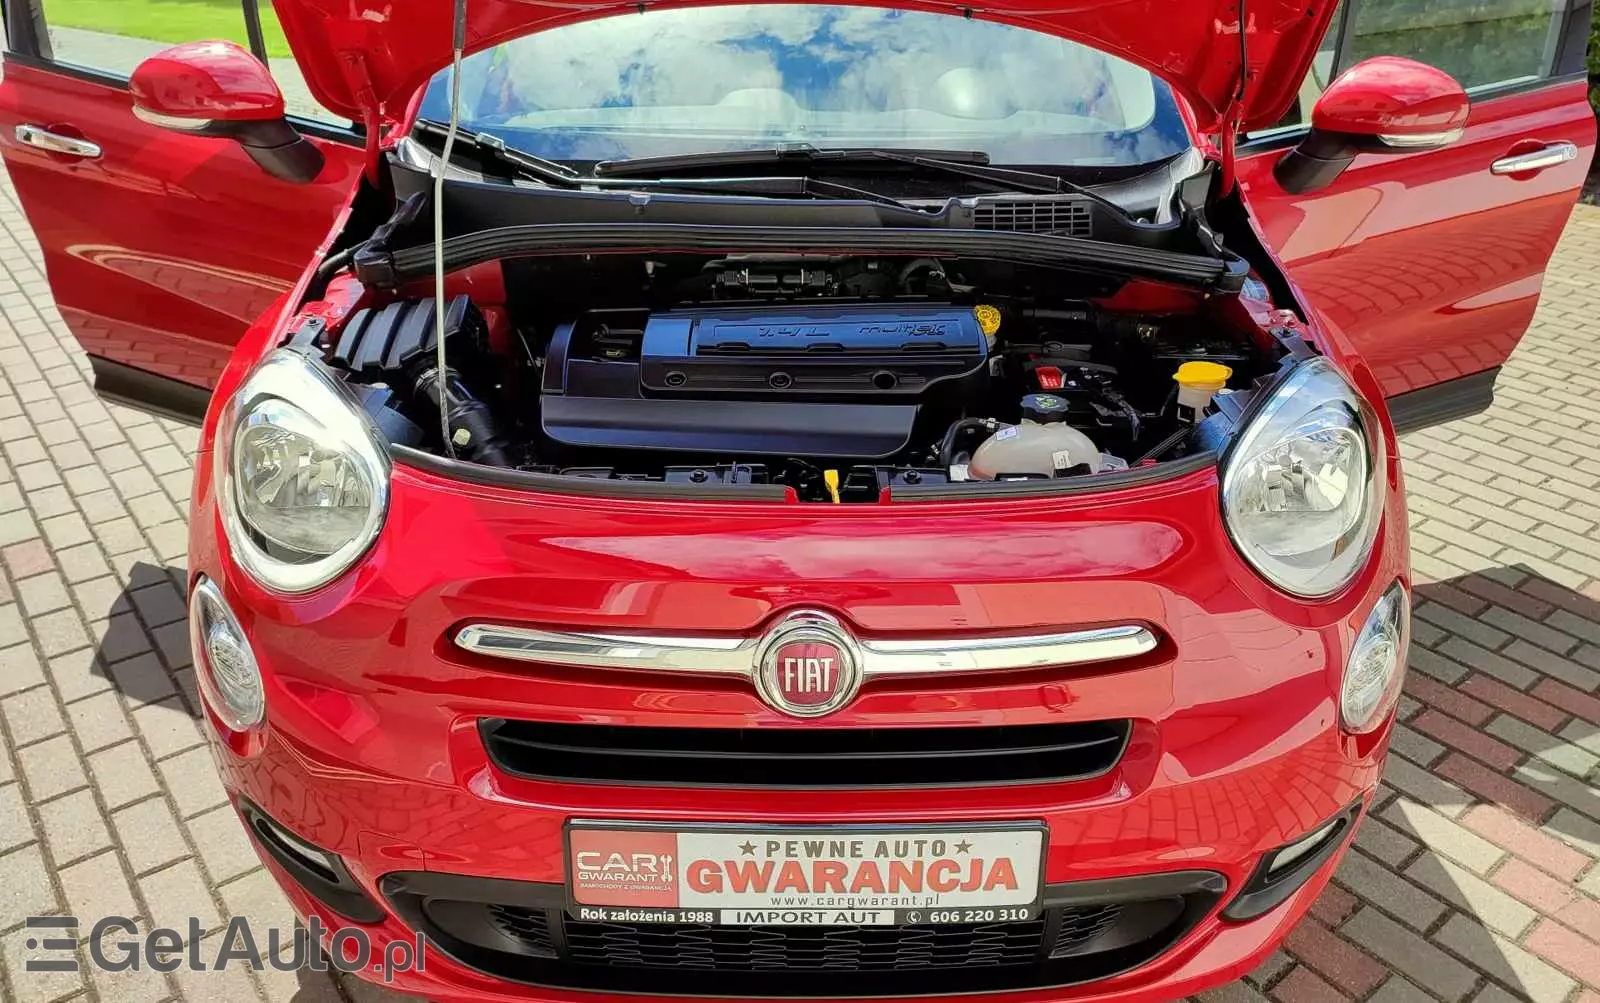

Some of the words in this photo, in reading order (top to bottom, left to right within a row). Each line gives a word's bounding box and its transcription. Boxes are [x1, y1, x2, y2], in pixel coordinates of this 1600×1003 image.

[784, 657, 834, 693] FIAT
[766, 840, 864, 858] PEWNE
[874, 839, 946, 858] AUTO
[576, 851, 658, 872] CAR
[577, 871, 658, 883] GWARANT
[686, 858, 1018, 893] GWARANCJA
[770, 894, 940, 909] www.cargwarant.pl
[580, 908, 608, 920] Rok
[610, 909, 675, 922] założenia
[679, 911, 714, 923] 1988
[736, 911, 826, 924] IMPORT
[834, 911, 881, 923] AUT
[930, 911, 960, 922] 606
[964, 910, 994, 922] 220
[998, 908, 1029, 920] 310
